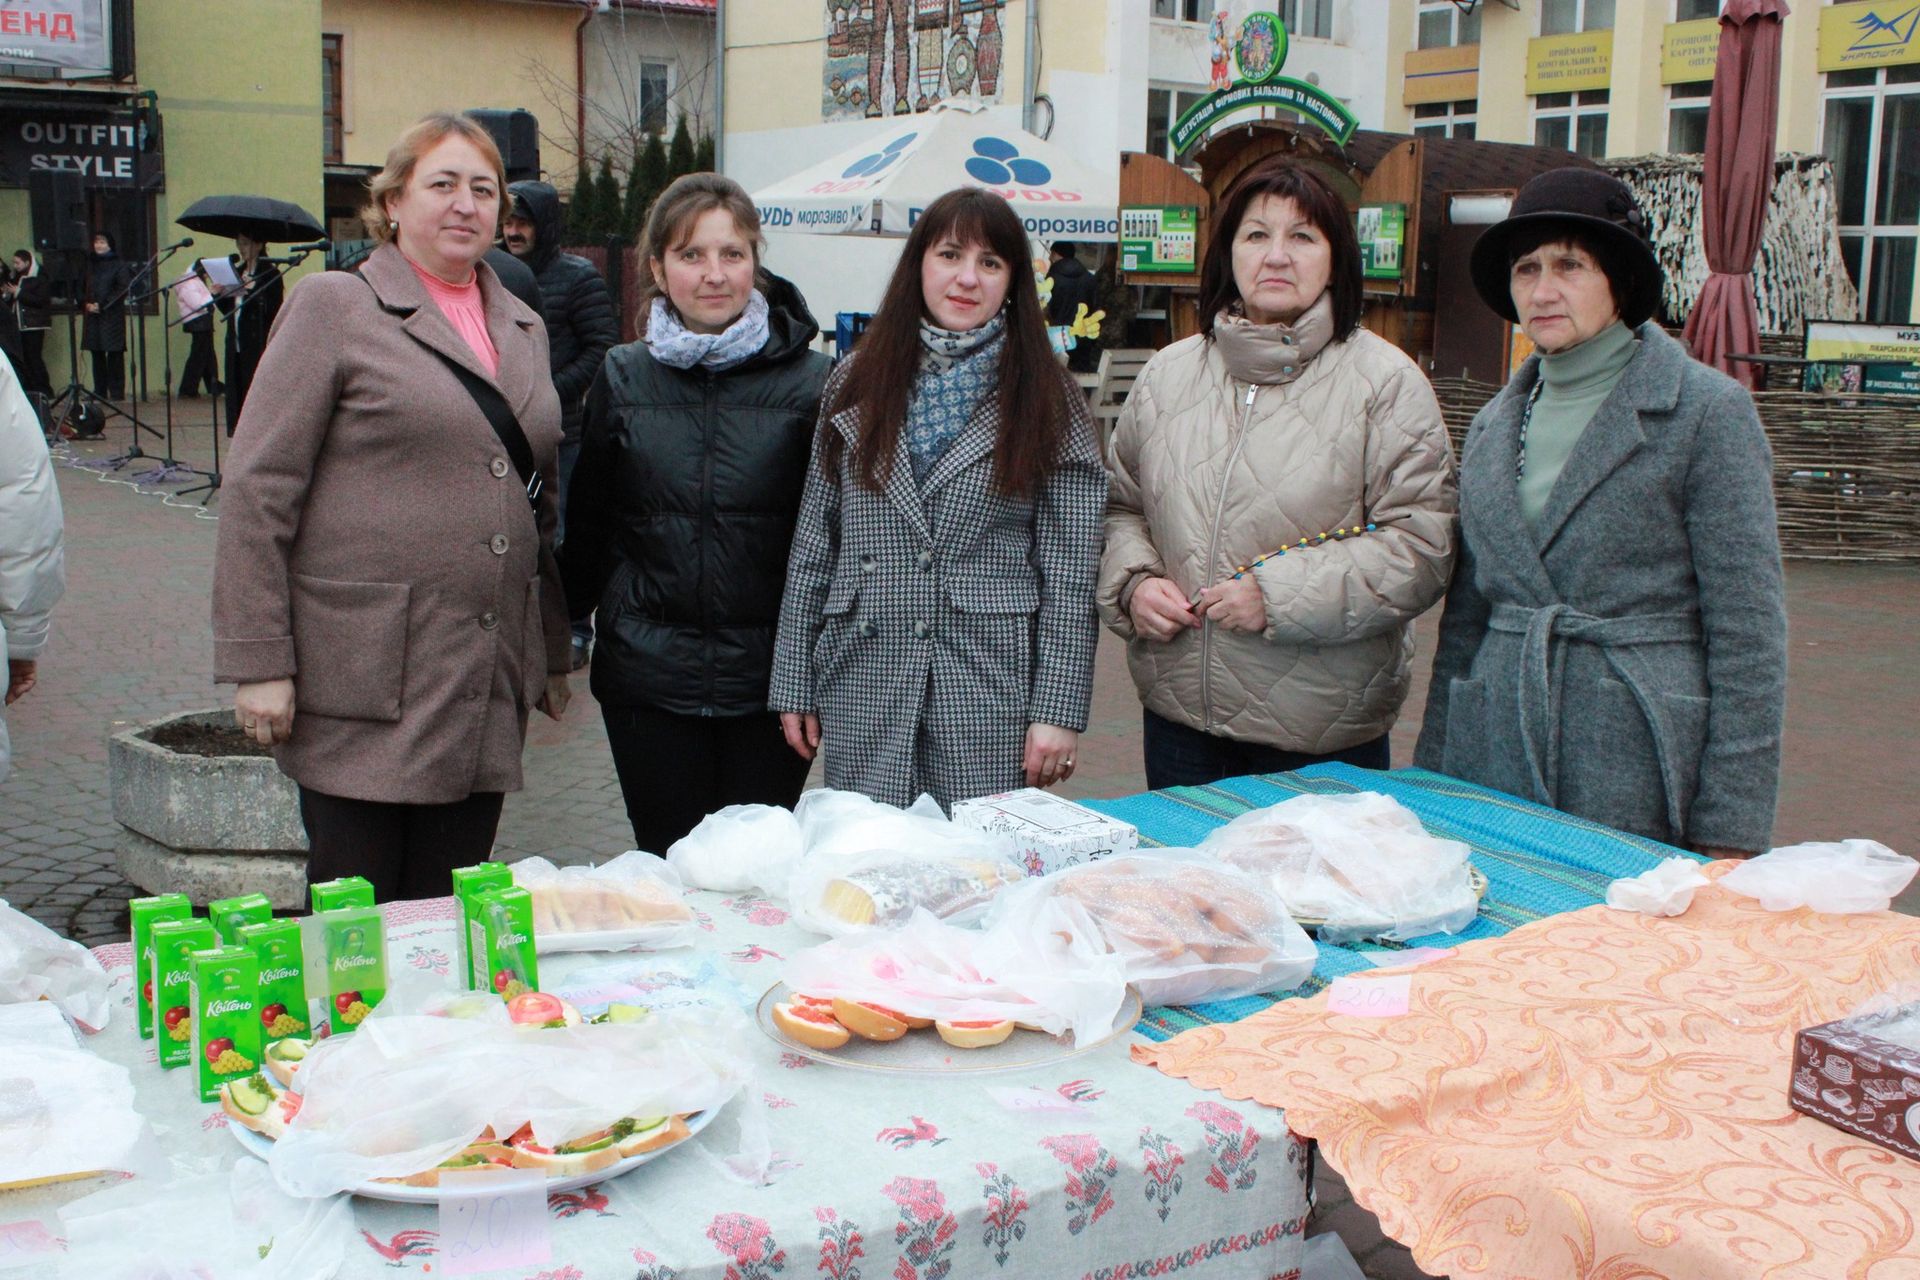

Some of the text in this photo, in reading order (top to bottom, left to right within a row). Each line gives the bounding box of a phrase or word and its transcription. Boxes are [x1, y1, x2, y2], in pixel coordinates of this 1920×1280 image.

[1177, 85, 1345, 143] ДЕГУСТАЦІЯ ФІРМОВИХ БАЛЬЗАМІВ ТА НАСТОЯНОК
[21, 121, 134, 147] OUTFIT
[30, 153, 133, 178] STYLE
[798, 209, 848, 227] морозиво
[1020, 217, 1118, 234] орозиво
[334, 953, 377, 972] Квітень
[258, 966, 299, 986] Квітень
[206, 999, 252, 1018] Квітень
[450, 1195, 512, 1259] 20
